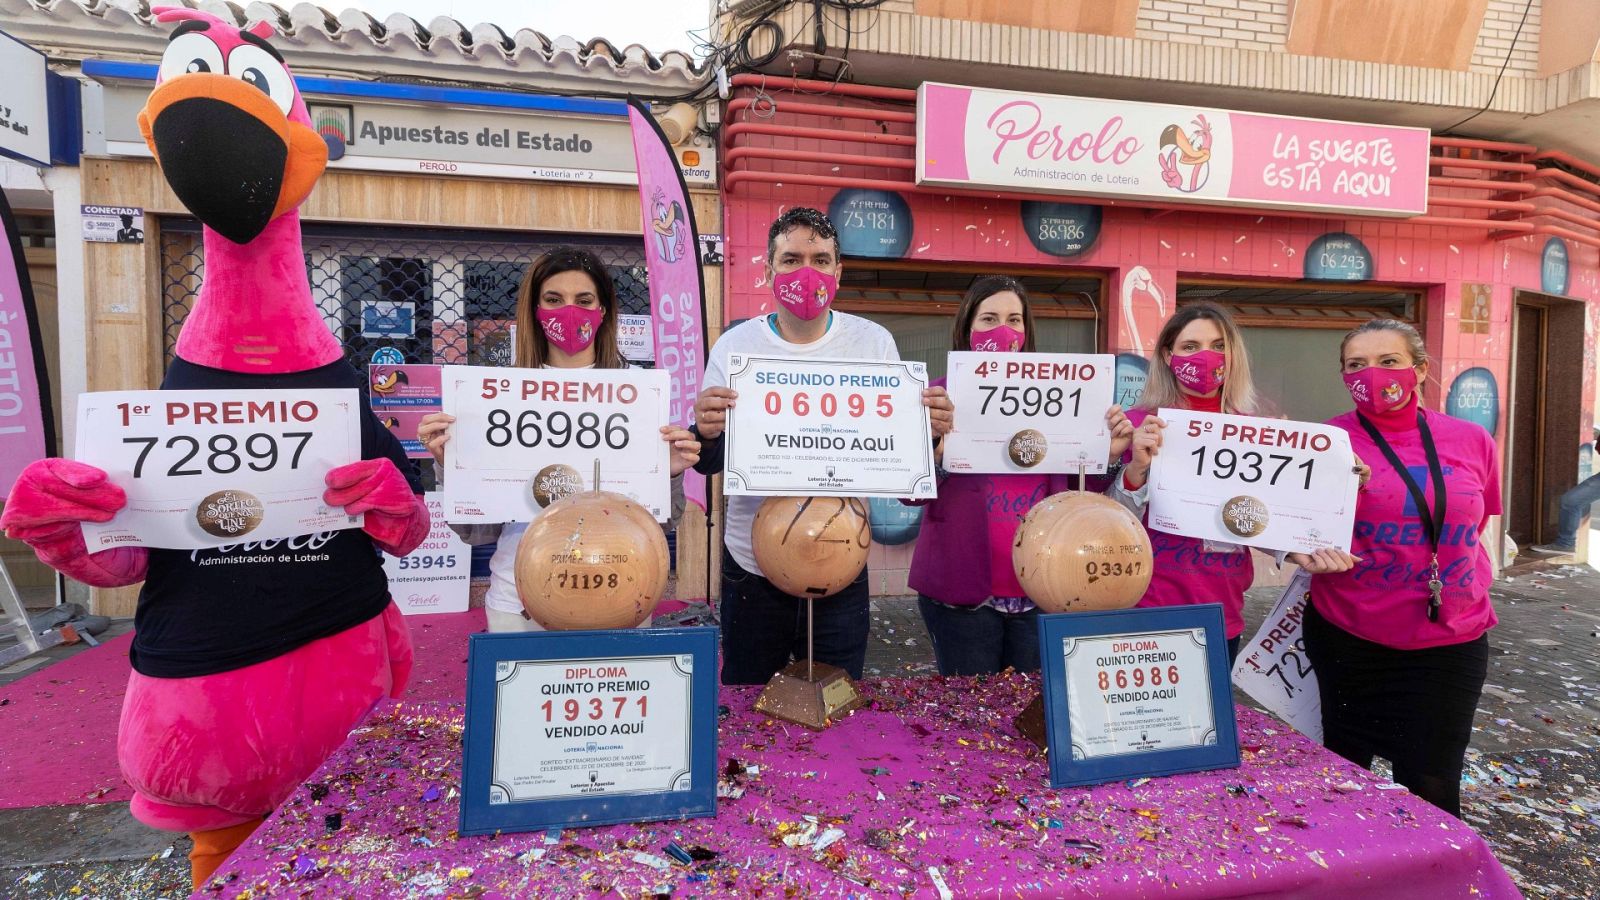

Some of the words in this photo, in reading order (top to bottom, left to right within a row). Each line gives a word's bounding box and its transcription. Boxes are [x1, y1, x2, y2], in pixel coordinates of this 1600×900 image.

[12, 122, 28, 135] del
[360, 120, 469, 145] Apuestas
[476, 127, 509, 148] del
[517, 131, 593, 153] Estado
[987, 99, 1144, 168] Perolo
[1273, 133, 1299, 160] LA
[1309, 138, 1395, 167] SUERTE
[419, 162, 458, 172] PEROLO
[588, 172, 594, 180] 2
[1091, 172, 1103, 183] de
[1263, 161, 1323, 192] ESTÁ
[1333, 166, 1398, 197] AQUÍ
[84, 206, 140, 215] CONECTADA
[843, 210, 895, 230] 75.981
[1039, 224, 1084, 240] 86.986
[779, 284, 804, 304] Premio
[547, 317, 564, 334] 1er
[974, 361, 998, 378] 4º
[1006, 362, 1096, 381] PREMIO
[1181, 361, 1200, 376] 1er
[756, 371, 835, 387] SEGUNDO
[840, 374, 901, 388] PREMIO
[1351, 379, 1368, 394] 1er
[481, 378, 511, 400] 5º
[521, 379, 638, 405] PREMIO
[978, 386, 1082, 418] 75981
[117, 402, 151, 427] 1er
[166, 400, 319, 426] PREMIO
[486, 408, 630, 450] 86986
[1187, 419, 1213, 438] 5º
[1221, 423, 1332, 452] PREMIO
[765, 433, 846, 450] VENDIDO
[850, 434, 894, 452] AQUÍ
[122, 431, 314, 479] 72897
[1190, 445, 1315, 490] 19371
[206, 498, 254, 518] SORTEO
[199, 554, 275, 567] Administración
[278, 554, 291, 563] de
[294, 553, 330, 562] Lotería
[398, 555, 456, 571] 53945
[592, 554, 629, 564] PREMIO
[1086, 561, 1143, 577] 03347
[396, 575, 467, 584] loteriasyapuestas.es
[557, 571, 618, 590] 71198
[1112, 641, 1159, 653] DIPLOMA
[1096, 655, 1136, 667] QUINTO
[1138, 651, 1177, 664] PREMIO
[565, 667, 628, 680] DIPLOMA
[1097, 665, 1179, 691] 86986
[541, 681, 594, 696] QUINTO
[598, 680, 650, 693] PREMIO
[1103, 690, 1150, 704] VENDIDO
[1152, 687, 1177, 700] AQUÍ
[541, 696, 648, 722] 19371
[545, 725, 607, 739] VENDIDO
[611, 721, 644, 736] AQUÍ
